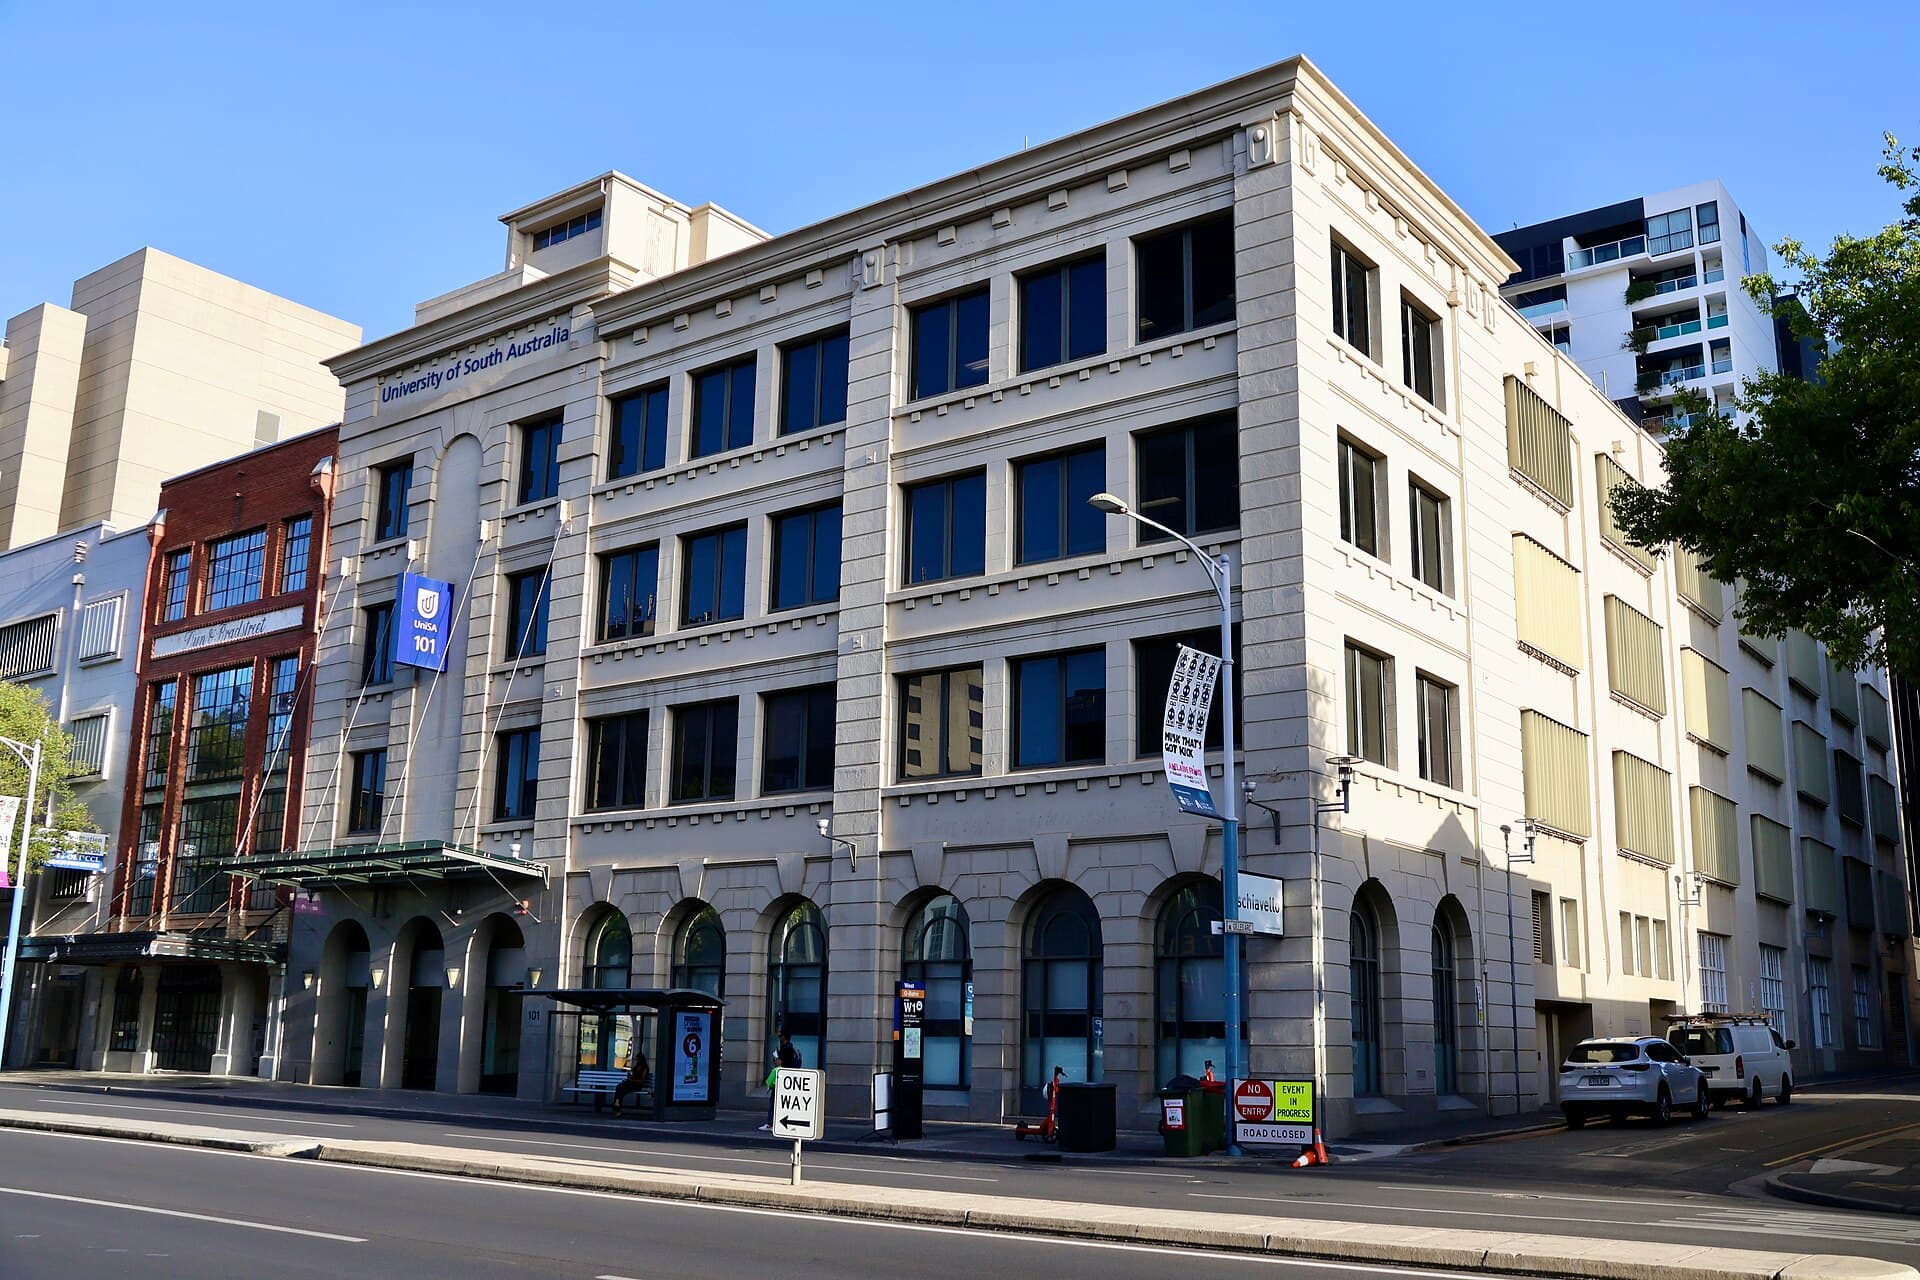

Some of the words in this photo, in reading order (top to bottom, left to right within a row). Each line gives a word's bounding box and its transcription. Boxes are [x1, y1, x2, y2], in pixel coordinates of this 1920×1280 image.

[382, 370, 443, 403] University
[446, 360, 462, 381] of
[464, 347, 503, 375] South
[506, 326, 569, 361] Australia
[413, 619, 438, 633] UniSA
[413, 635, 437, 655] 101
[1164, 742, 1178, 754] GOT
[528, 1009, 540, 1021] 101
[783, 1075, 811, 1092] ONE
[1247, 1084, 1261, 1094] NO
[1282, 1085, 1305, 1095] EVENT
[780, 1094, 812, 1112] WAY
[1289, 1097, 1298, 1106] IN
[1241, 1107, 1267, 1116] ENTRY
[1277, 1108, 1310, 1119] PROGRESS
[1243, 1128, 1268, 1138] ROAD
[1270, 1129, 1306, 1139] CLOSED
